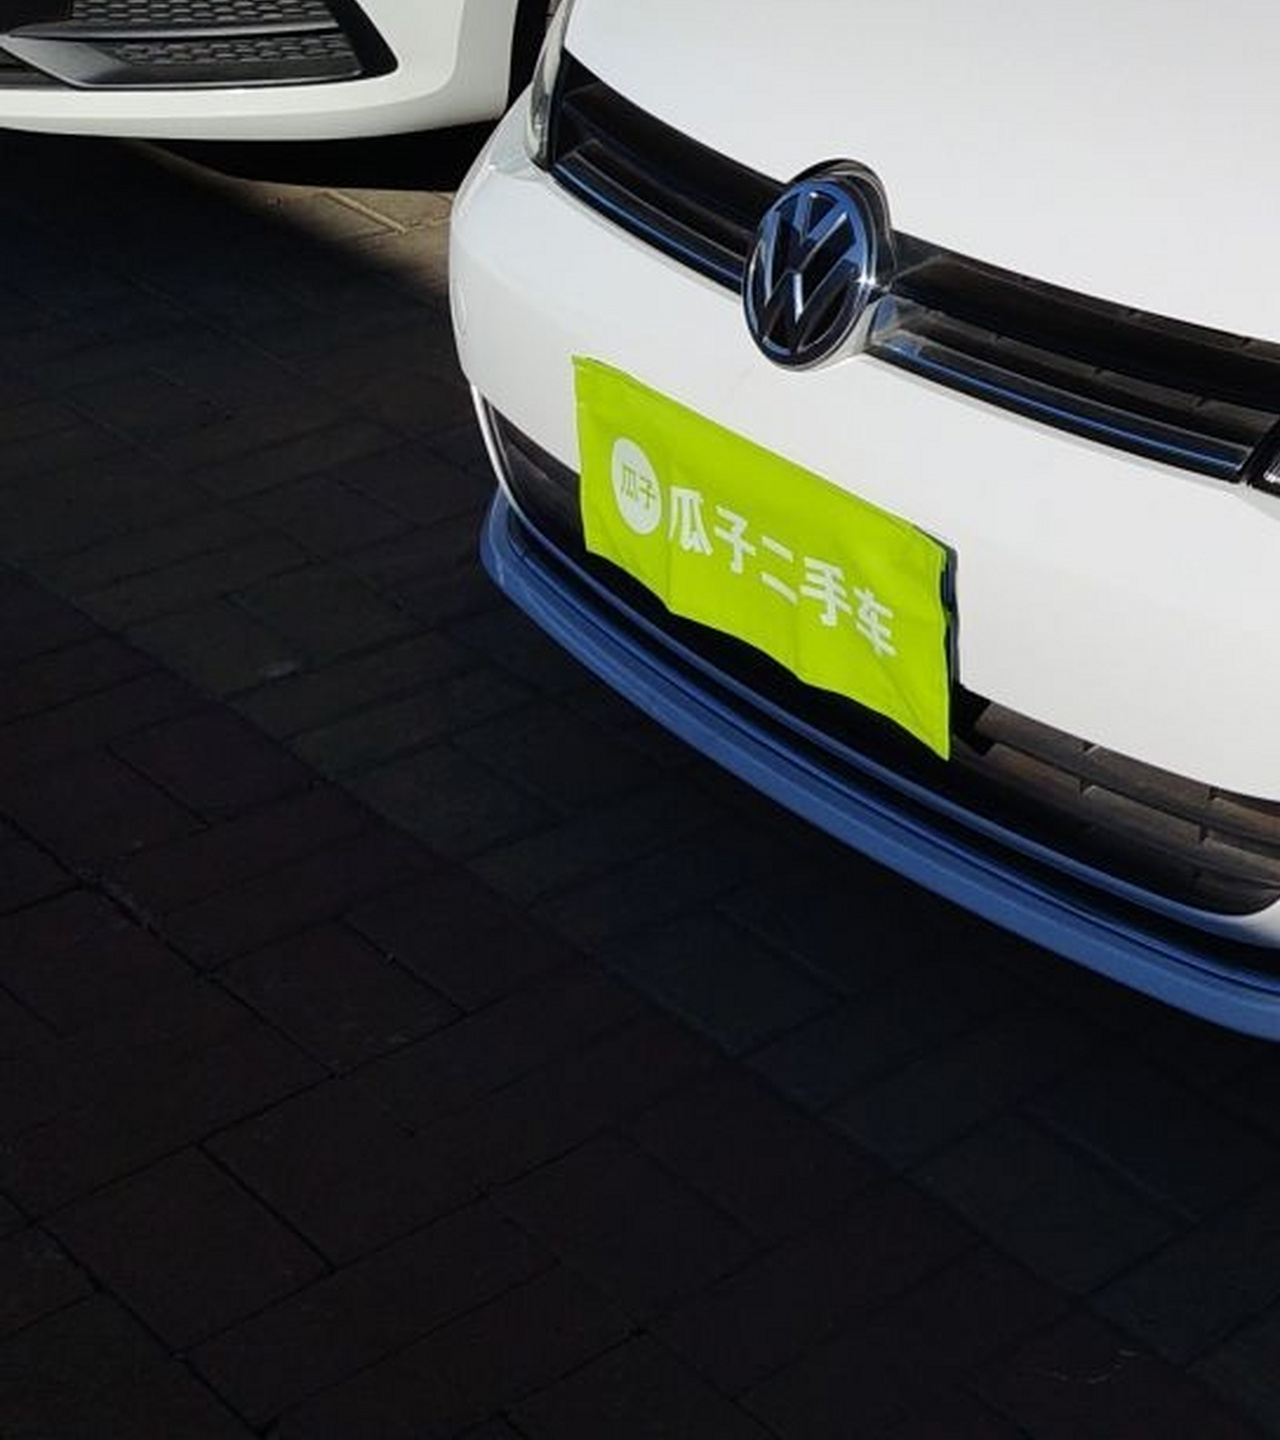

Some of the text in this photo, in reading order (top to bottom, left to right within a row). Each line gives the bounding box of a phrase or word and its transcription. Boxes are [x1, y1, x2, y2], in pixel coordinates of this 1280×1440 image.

[620, 462, 658, 511] 瓜子
[669, 486, 896, 656] 瓜子二手车
